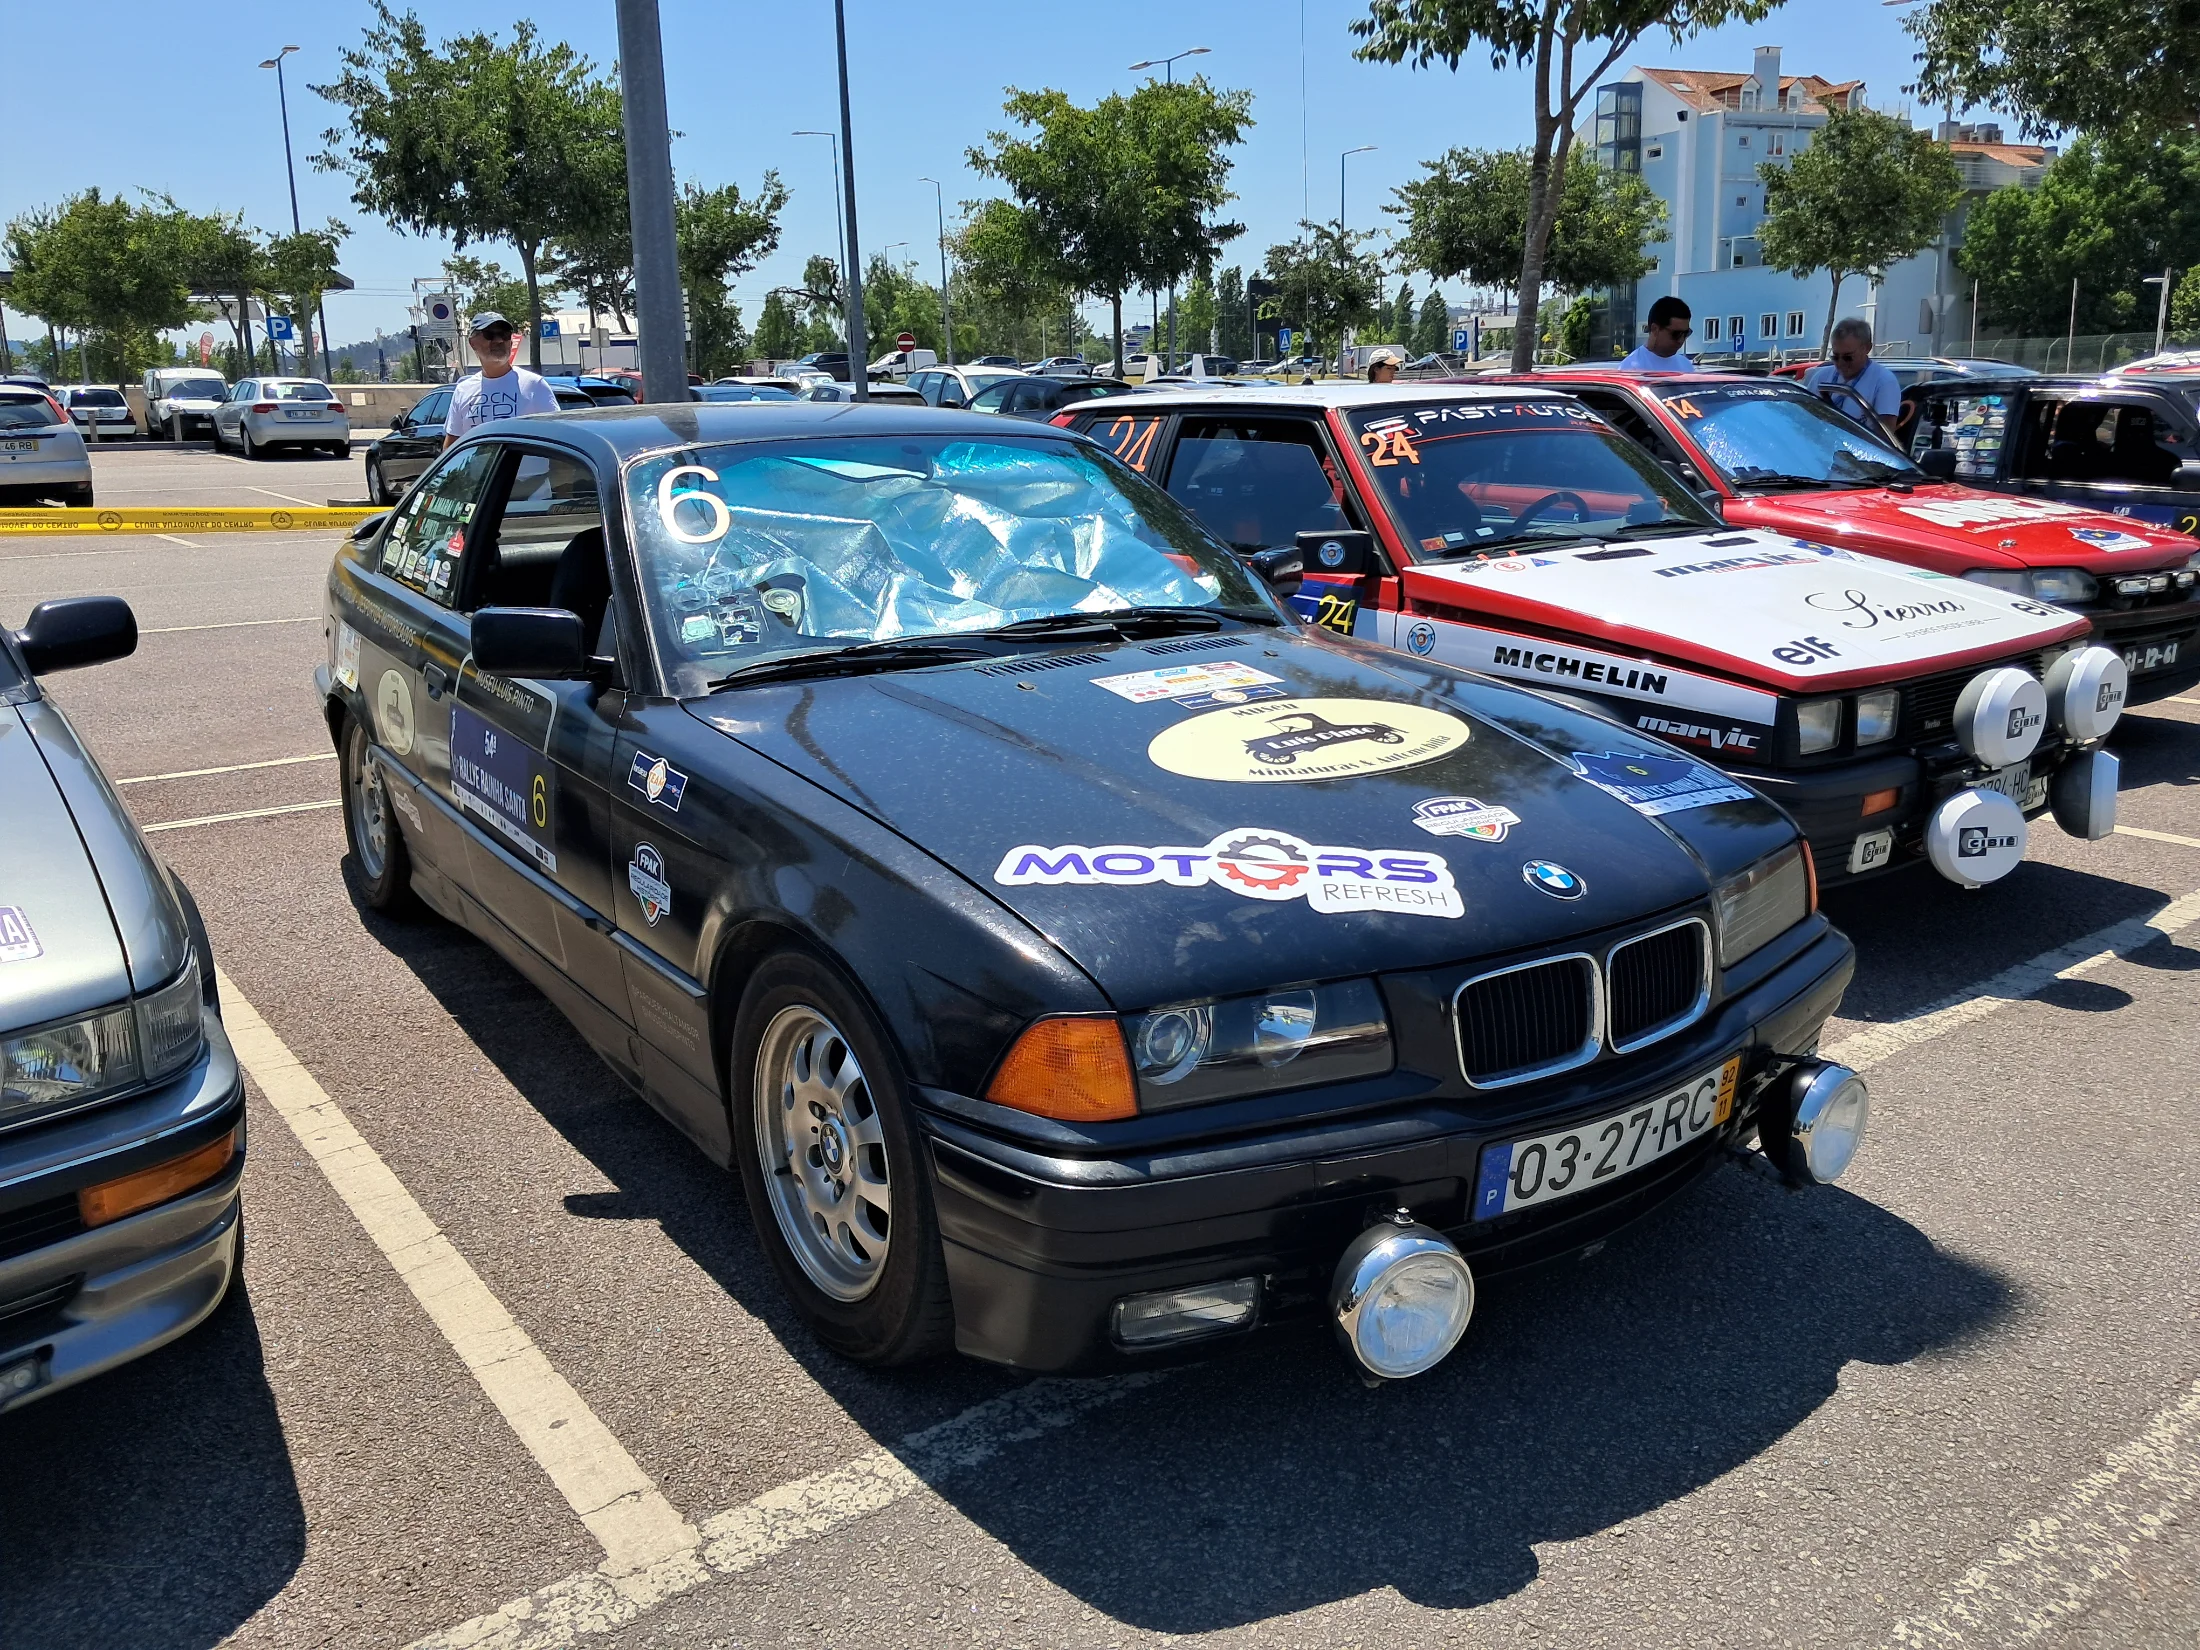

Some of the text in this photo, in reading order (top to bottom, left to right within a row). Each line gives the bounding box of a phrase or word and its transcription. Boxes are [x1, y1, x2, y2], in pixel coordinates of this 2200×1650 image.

[1665, 399, 1704, 420] 14
[1109, 415, 1160, 472] 24
[1360, 431, 1420, 468] 24
[658, 465, 731, 544] 6
[1319, 594, 1356, 634] 24
[1804, 588, 1966, 629] Sierra
[1772, 635, 1843, 666] elf
[1492, 645, 1668, 695] MICHELIN
[513, 689, 535, 714] PINTO
[1230, 702, 1299, 718] Museu
[1315, 725, 1377, 741] Pinto
[1636, 714, 1762, 750] marvic
[1248, 760, 1360, 777] Miniaturas
[1626, 765, 1649, 776] 6
[459, 756, 528, 824] RALLYE RAINHA SANTA
[533, 774, 546, 827] 6
[1427, 801, 1474, 815] FPAK
[640, 853, 659, 877] FPAK
[1322, 883, 1449, 907] REFRESH
[1721, 1065, 1737, 1087] 92
[1718, 1101, 1728, 1117] 11
[1485, 1188, 1498, 1206] P
